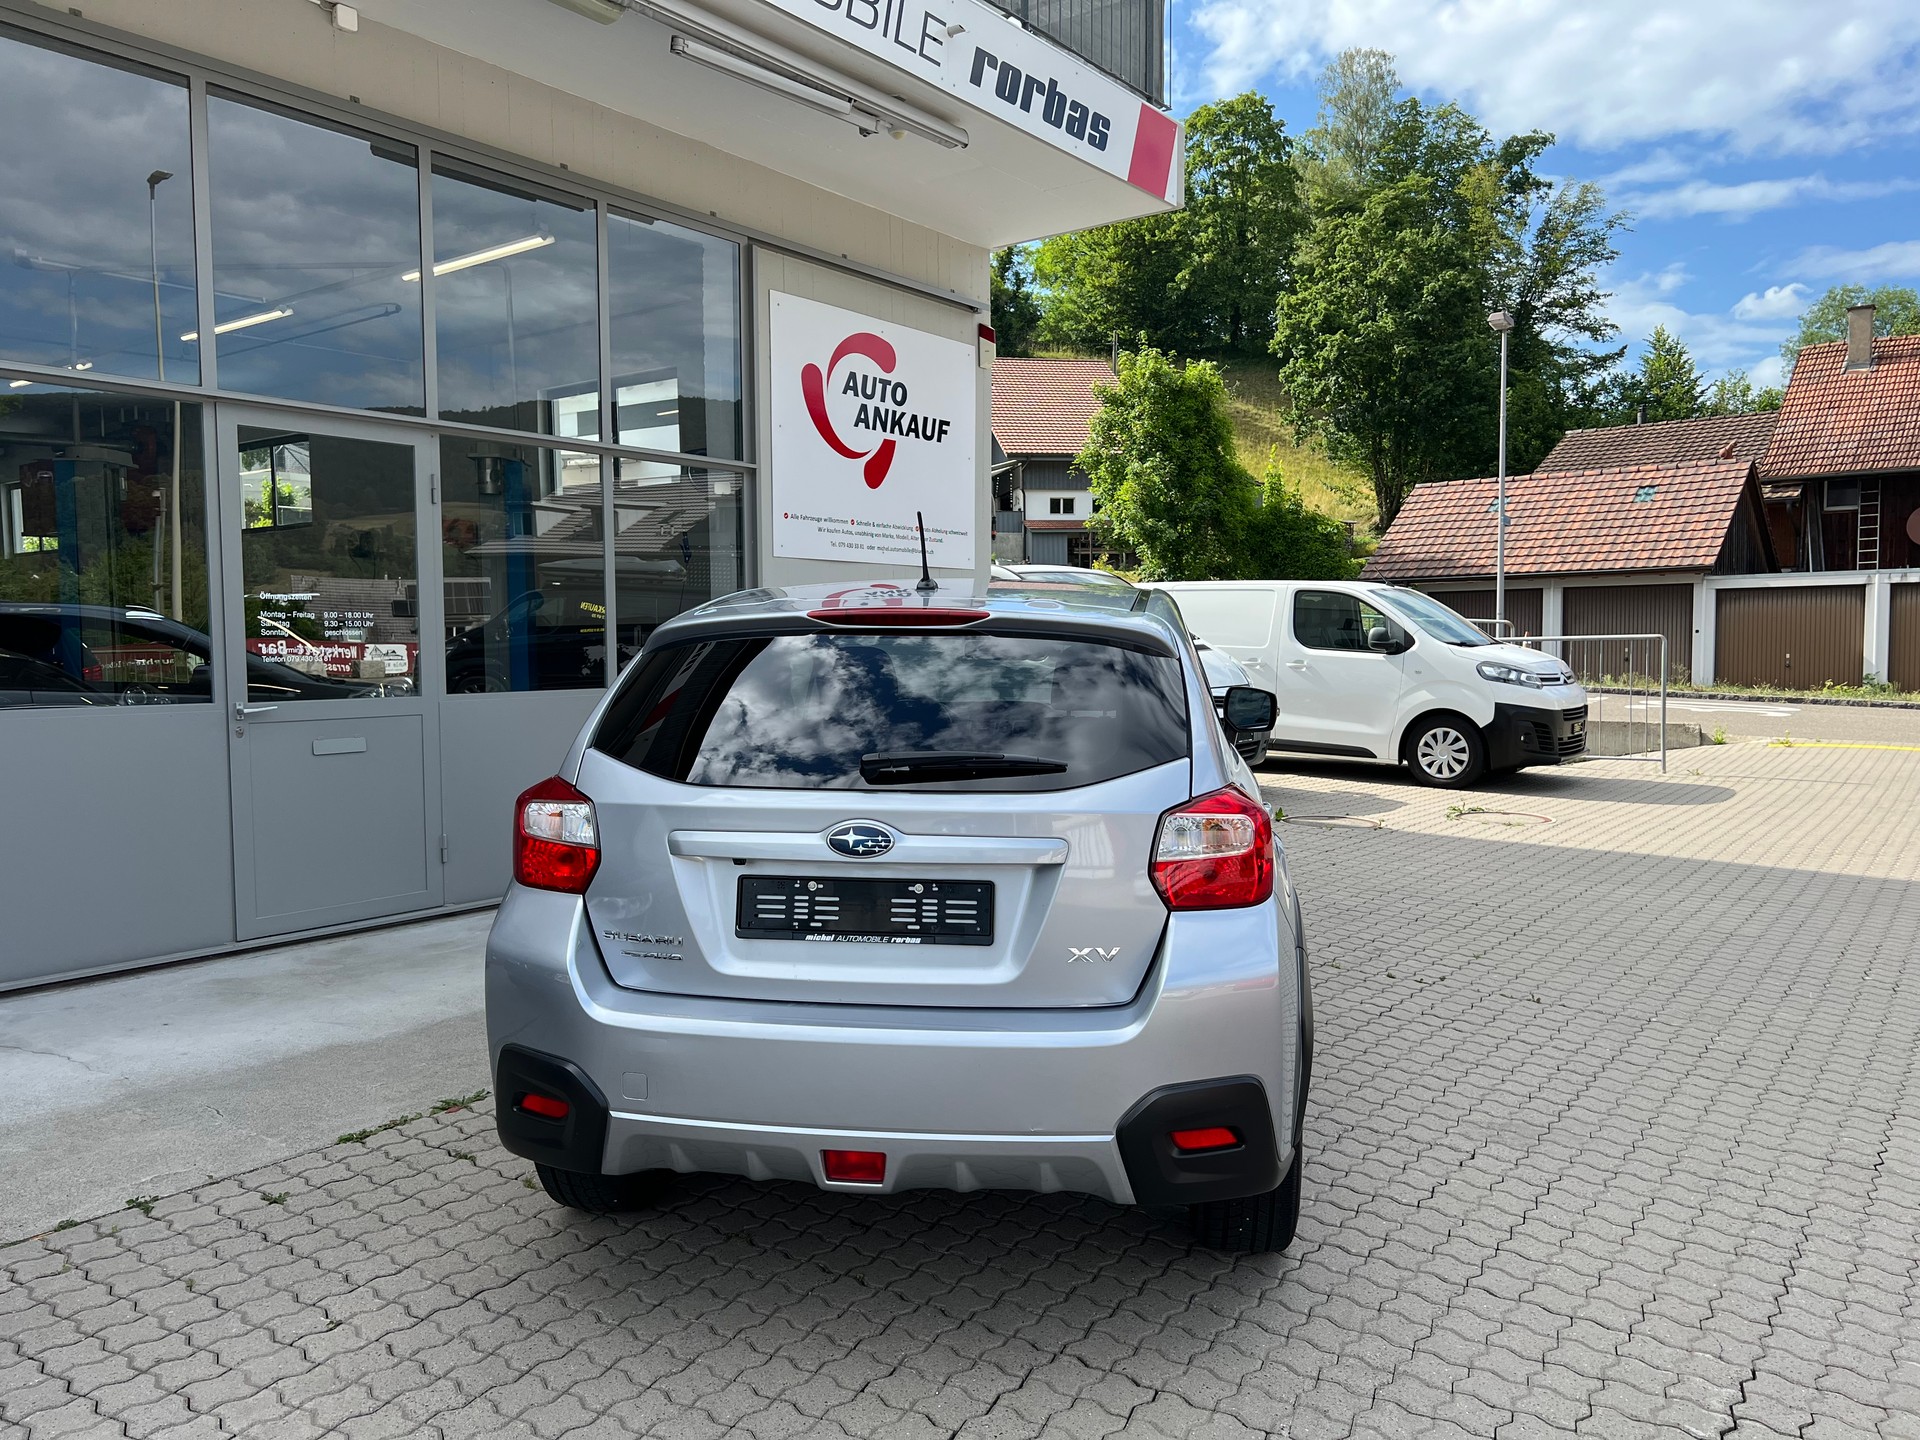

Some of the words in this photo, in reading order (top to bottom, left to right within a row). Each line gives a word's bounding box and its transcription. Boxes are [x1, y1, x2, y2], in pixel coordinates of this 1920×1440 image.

[813, 0, 947, 67] BILE
[969, 46, 1111, 152] rorbas
[842, 371, 908, 407] AUTO
[853, 403, 950, 443] ANKAUF
[260, 610, 286, 619] Montag
[292, 611, 315, 620] Freitag
[260, 619, 290, 628] Satag
[260, 629, 289, 637] Sonntag
[324, 630, 362, 638] geschlossen
[261, 655, 286, 663] Telefon
[602, 930, 684, 946] SUBARU
[804, 933, 835, 941] michel
[835, 934, 889, 943] AUTOMOBILE
[890, 936, 921, 944] rorbas
[1066, 946, 1121, 963] XV
